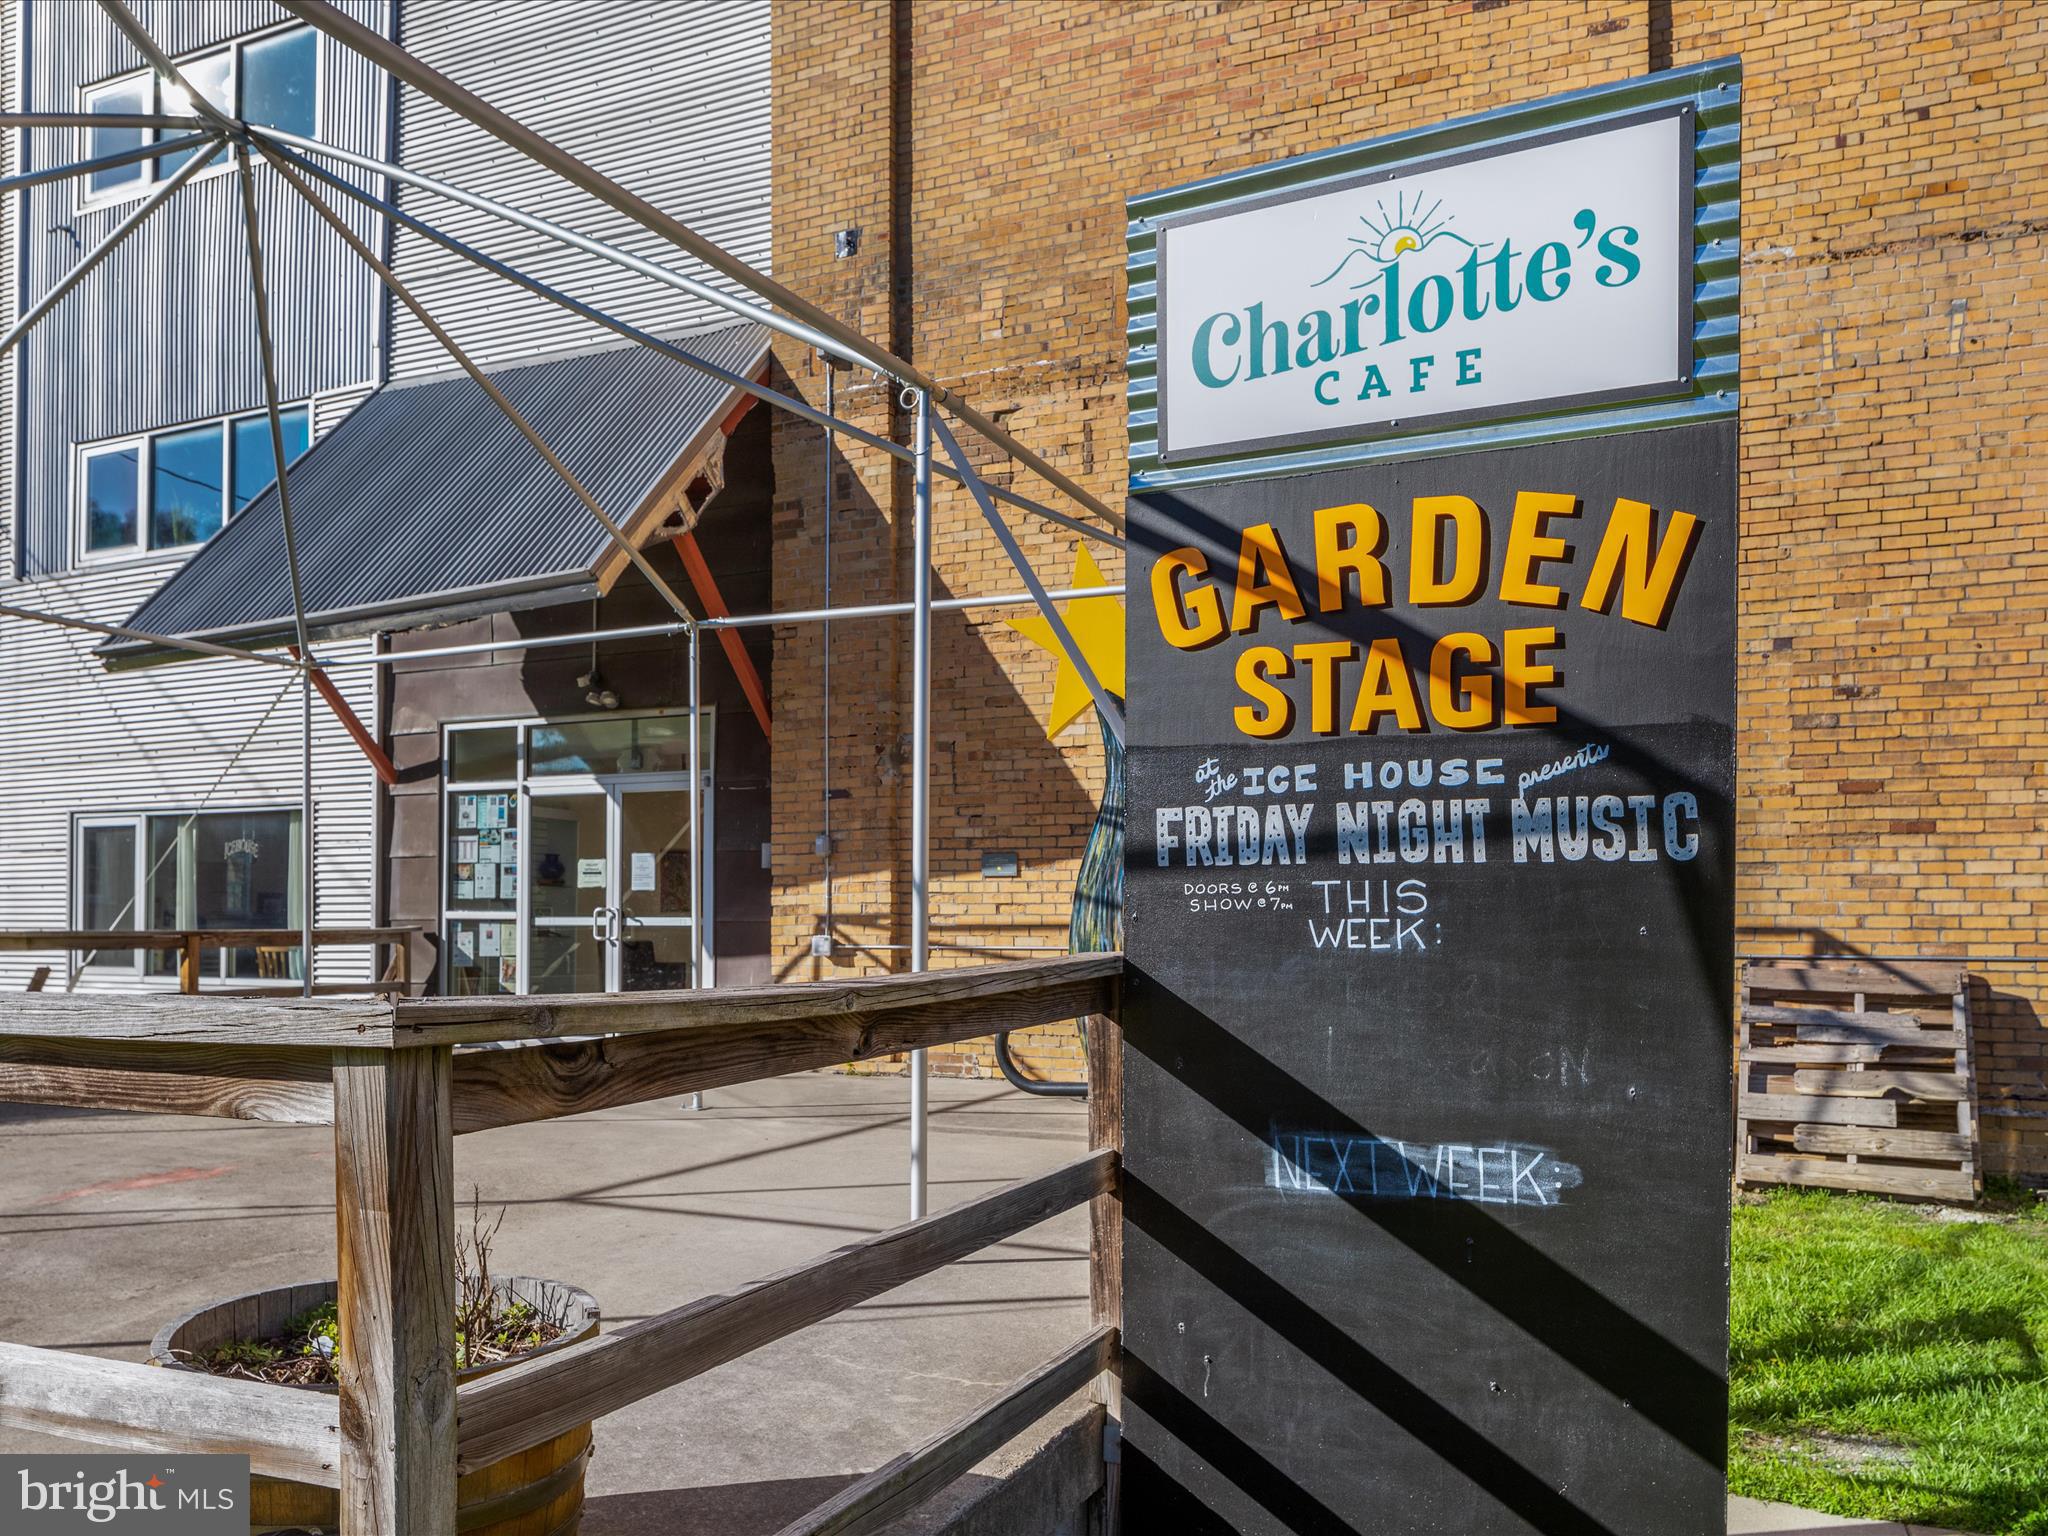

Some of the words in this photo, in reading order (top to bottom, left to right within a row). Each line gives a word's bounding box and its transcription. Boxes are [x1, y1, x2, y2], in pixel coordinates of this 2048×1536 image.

[1191, 208, 1640, 389] Charlotte's
[1314, 347, 1482, 405] CAFE
[1150, 490, 1698, 649] GARDEN
[1233, 626, 1559, 737] STAGE
[1195, 757, 1221, 783] at
[1204, 771, 1239, 803] the
[1243, 763, 1318, 796] ICE
[1344, 758, 1505, 790] HOUSE
[1518, 743, 1610, 799] presents
[1156, 803, 1315, 867] FRIDAY
[1336, 798, 1491, 865] NIGHT
[1511, 791, 1699, 864] MUSIC
[1184, 882, 1242, 895] DOORS
[1190, 898, 1253, 912] SHOW
[1311, 879, 1428, 914] THIS
[1308, 918, 1442, 951] WEEK:
[1274, 1135, 1386, 1195] NEXT
[1398, 1141, 1563, 1206] WEEK:
